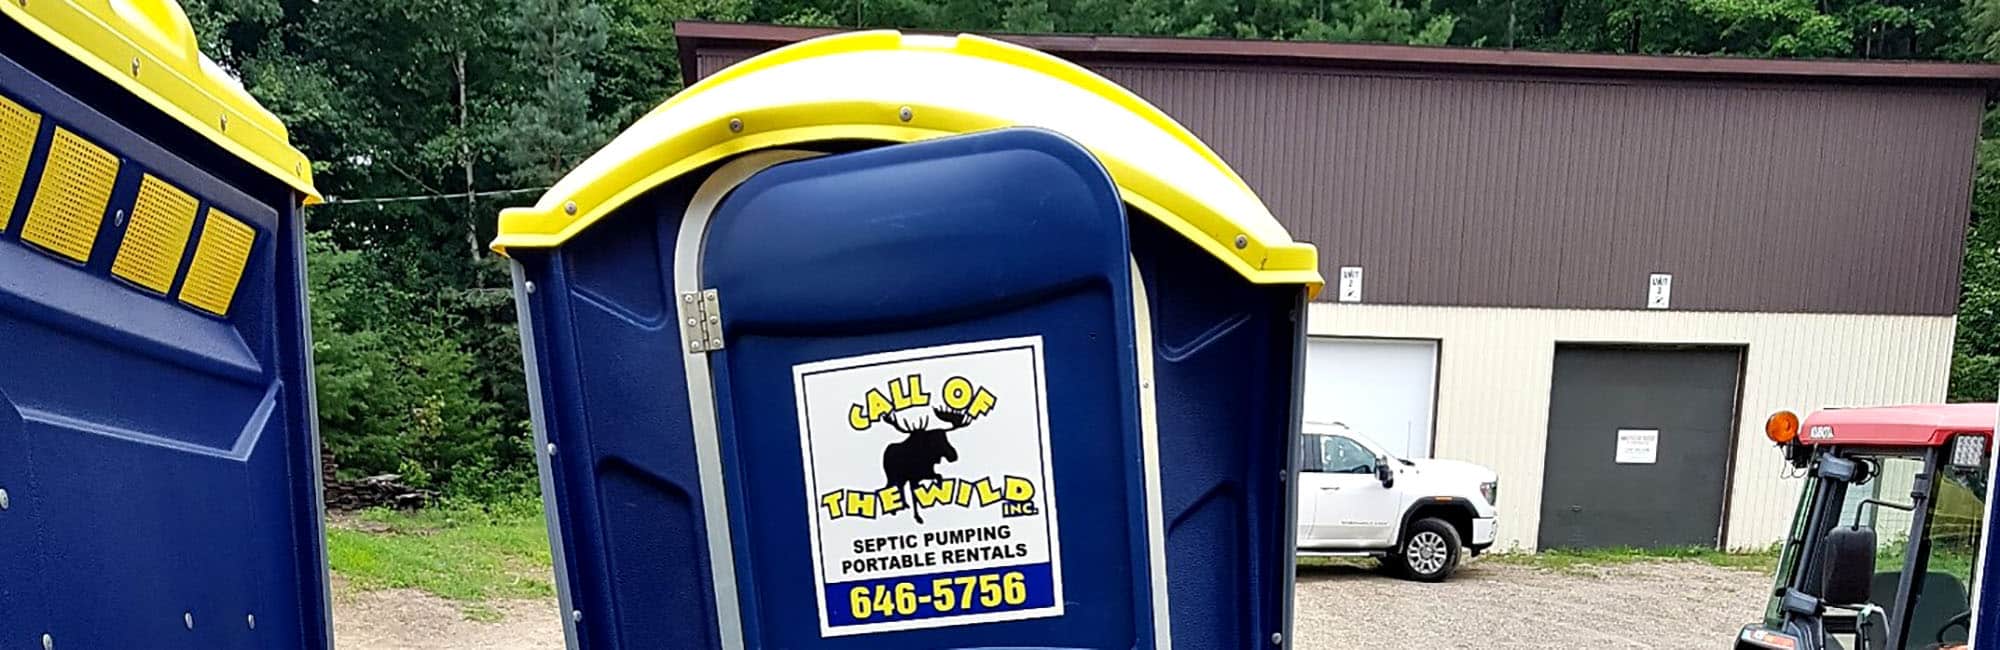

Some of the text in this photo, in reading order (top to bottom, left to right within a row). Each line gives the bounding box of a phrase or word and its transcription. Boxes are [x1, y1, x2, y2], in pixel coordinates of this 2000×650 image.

[849, 374, 997, 430] CALL OF
[821, 475, 1035, 520] THE WILD
[1002, 502, 1038, 518] INC.
[842, 543, 1028, 574] PORTABLE RENTALS
[853, 525, 1011, 554] SEPTIC PUMPING
[849, 571, 1027, 619] 646-5756
